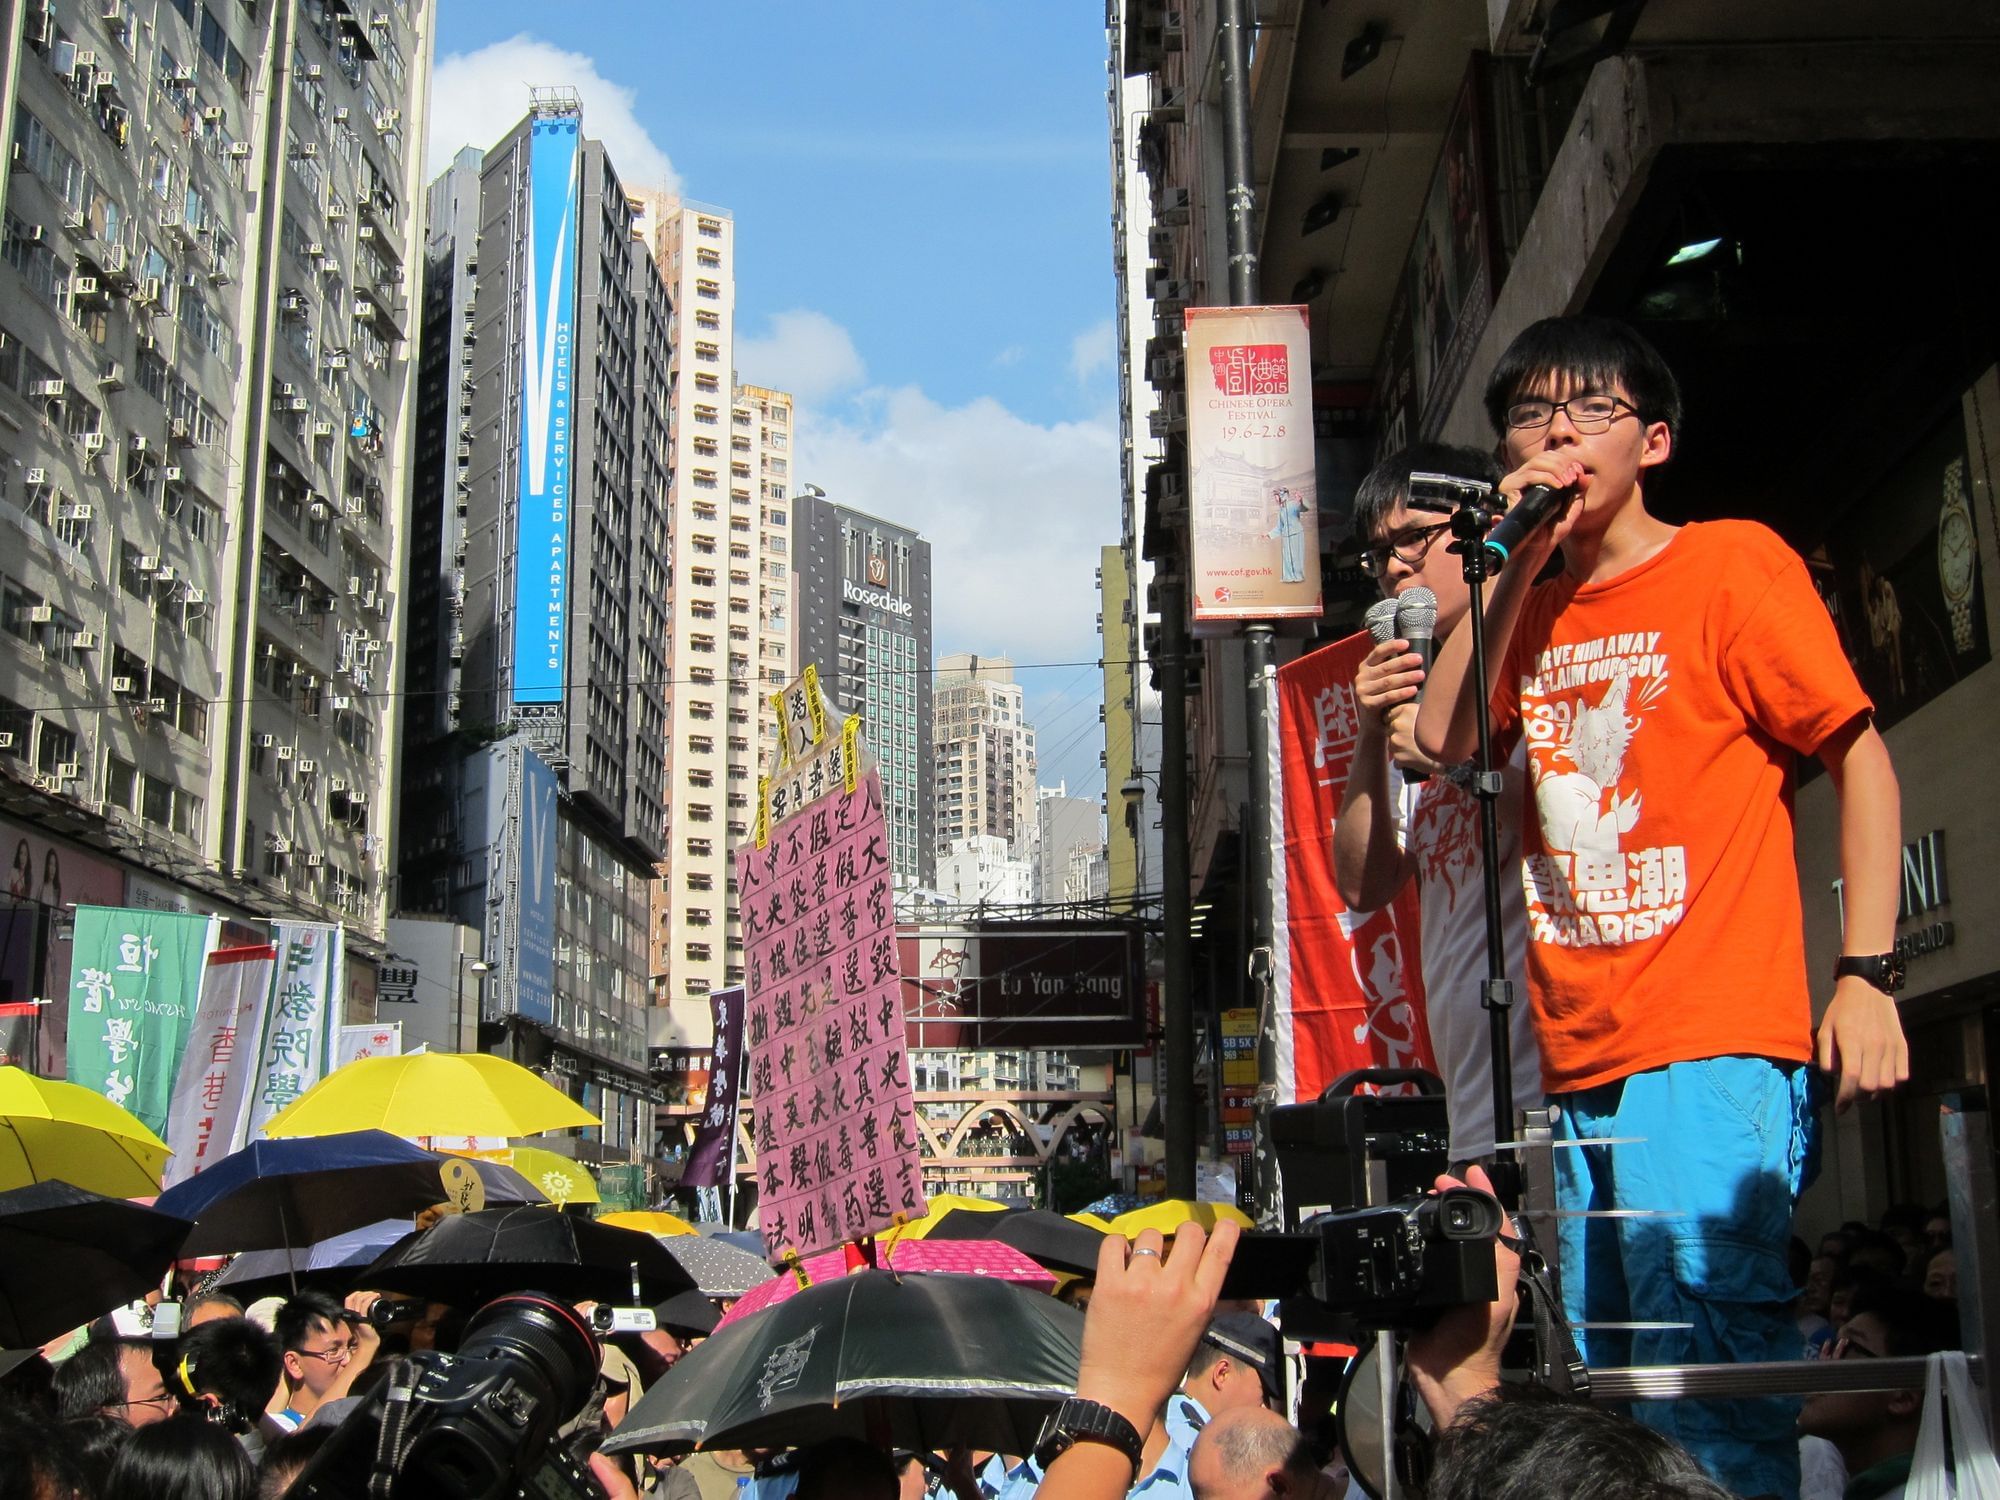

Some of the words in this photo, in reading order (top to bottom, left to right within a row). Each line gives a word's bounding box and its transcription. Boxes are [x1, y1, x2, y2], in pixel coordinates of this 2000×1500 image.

[556, 322, 570, 392] HOTELS
[1255, 382, 1288, 394] 2015
[556, 399, 566, 408] &
[1208, 399, 1254, 410] CHINESE
[1257, 397, 1293, 408] OPERA
[1228, 410, 1277, 421] FESTIVAL
[551, 416, 566, 522] SERVICED
[547, 532, 563, 669] APARTMENTS
[843, 578, 913, 617] Rosedale
[1573, 637, 1604, 663] HIM
[1605, 632, 1662, 656] AWAY
[1030, 972, 1064, 995] Yan
[1239, 1038, 1252, 1048] 5X
